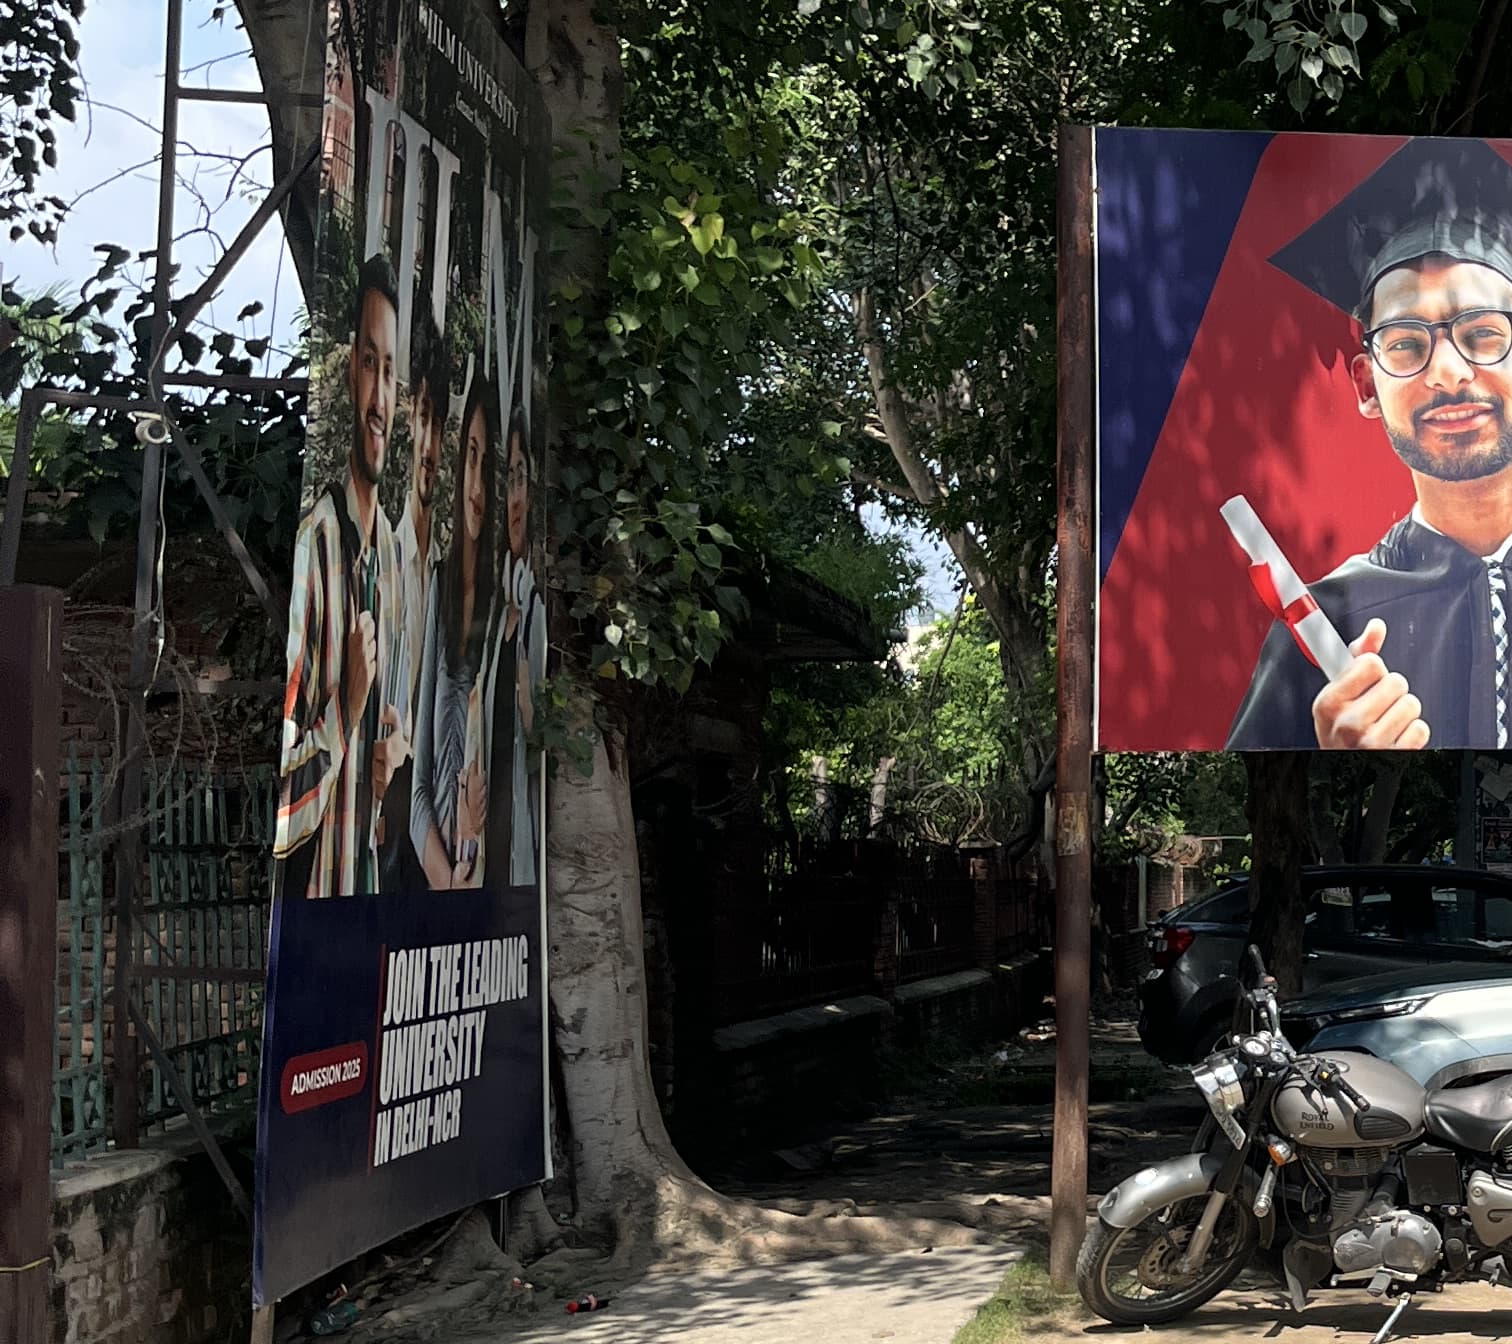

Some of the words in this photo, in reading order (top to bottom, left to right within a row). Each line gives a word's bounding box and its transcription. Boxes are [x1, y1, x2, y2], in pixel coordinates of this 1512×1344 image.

[457, 41, 519, 136] UNIVERSITY
[383, 947, 428, 1027] JOIN
[428, 943, 462, 1017] THE
[461, 934, 529, 1010] LEADING
[290, 1063, 342, 1096] ADMISSION
[341, 1057, 361, 1082] 2025
[379, 1009, 487, 1106] UNIVERSITY
[373, 1108, 392, 1168] IN
[390, 1088, 462, 1161] DELHI-NCR
